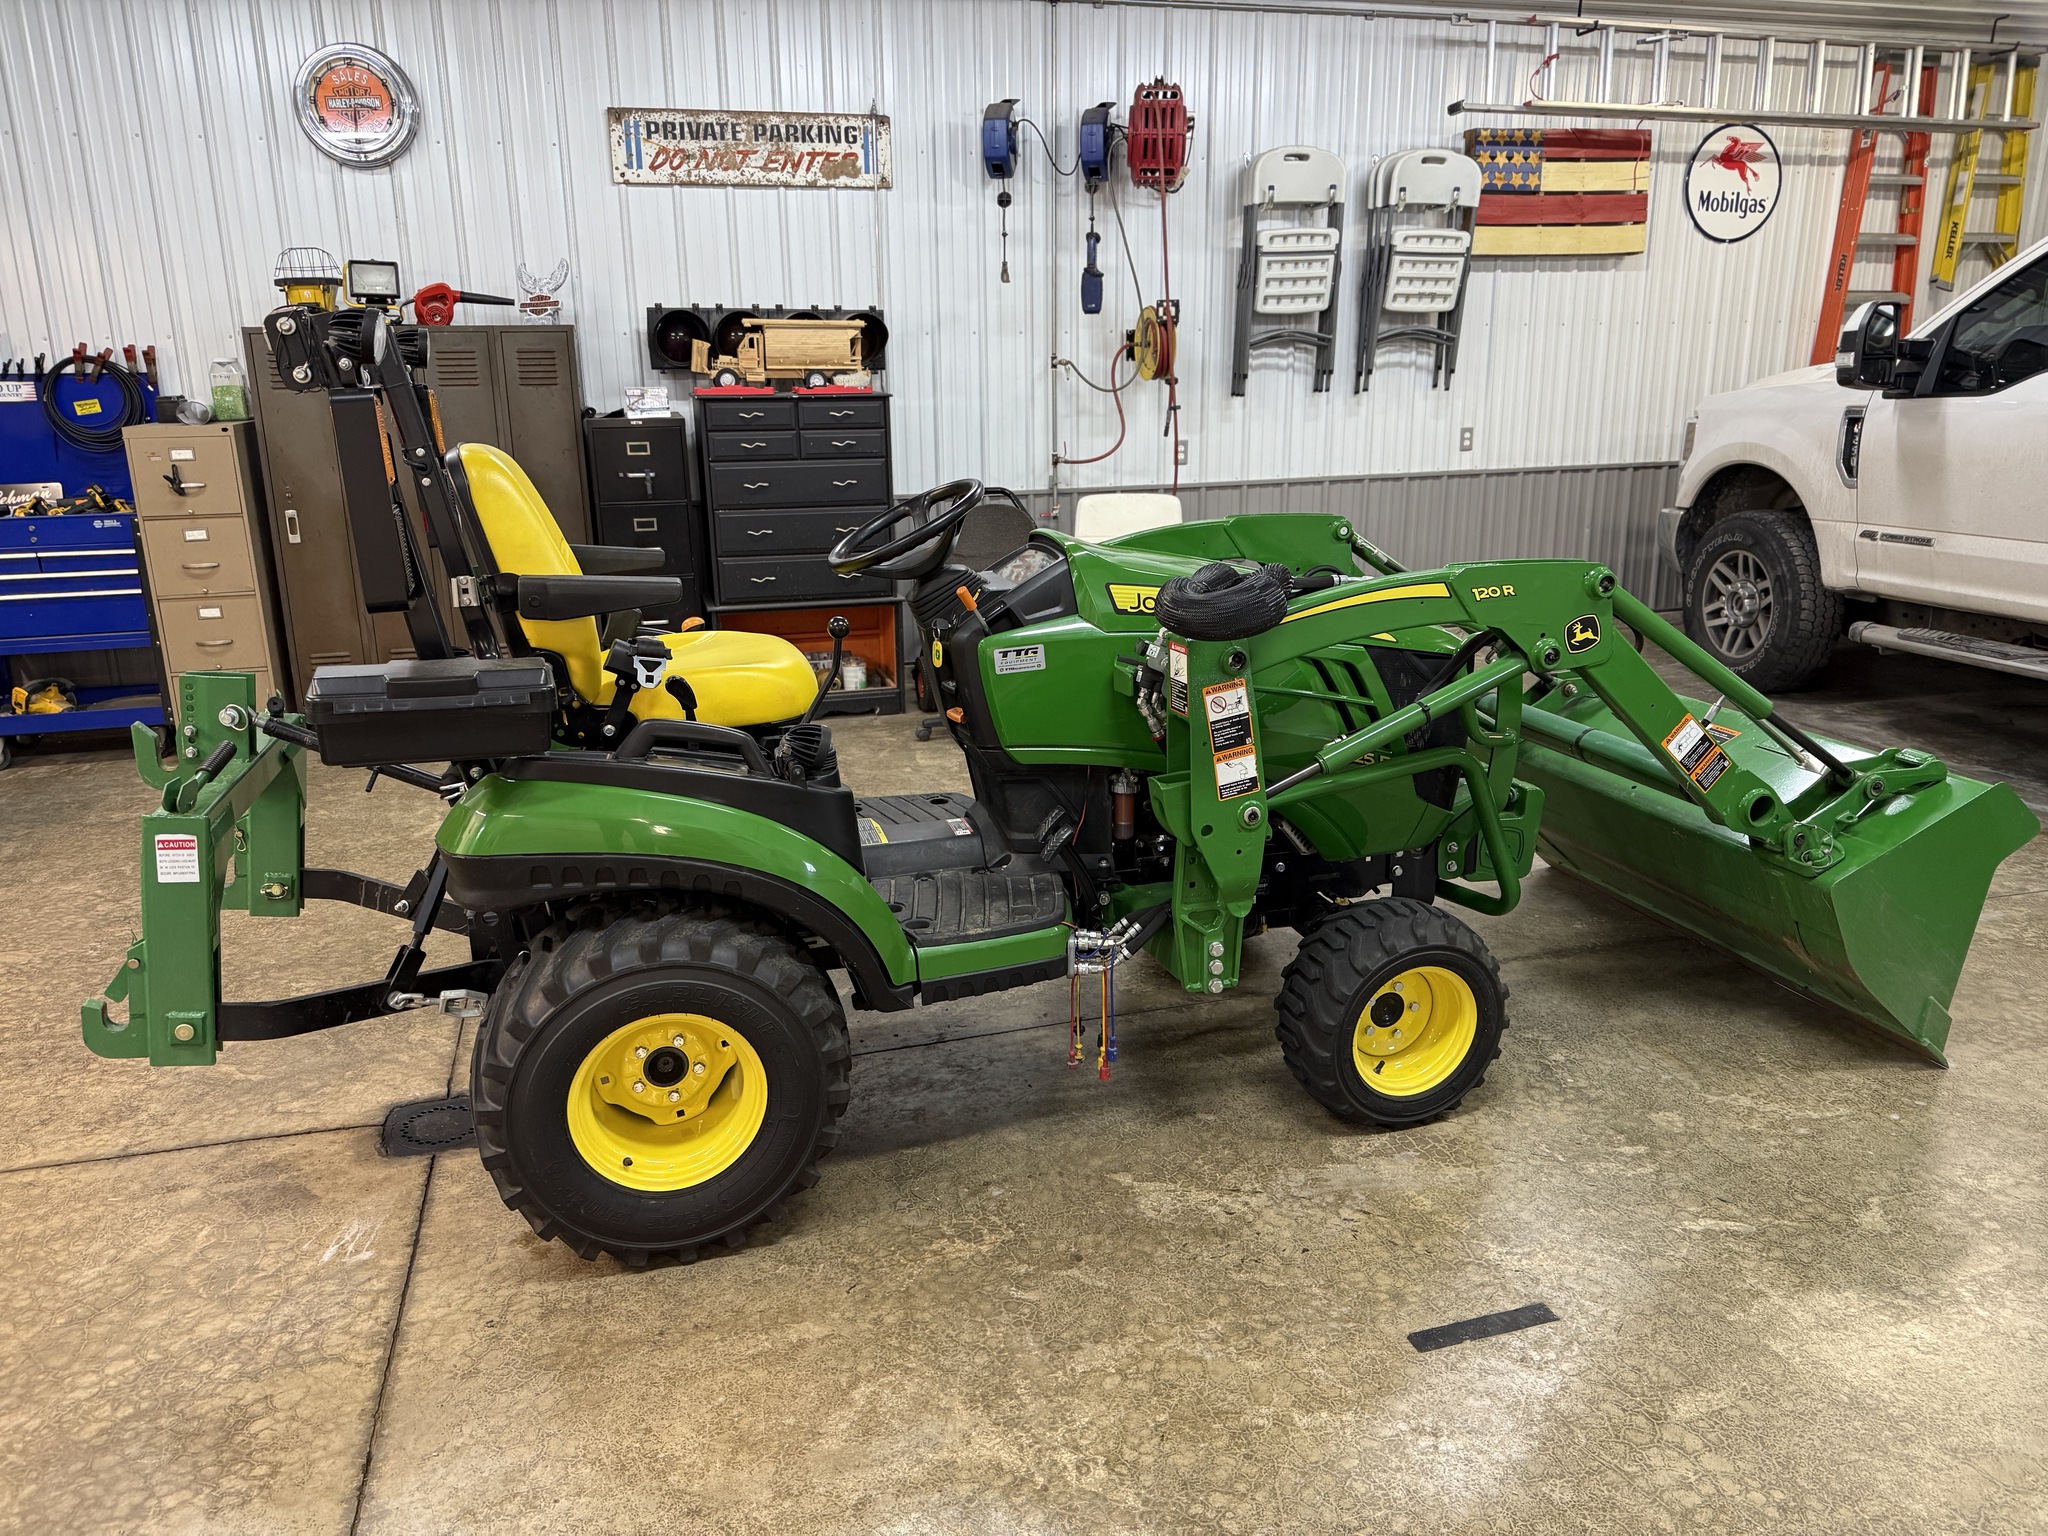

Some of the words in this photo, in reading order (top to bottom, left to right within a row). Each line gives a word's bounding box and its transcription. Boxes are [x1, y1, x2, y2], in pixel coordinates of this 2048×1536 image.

[331, 69, 368, 85] SALES
[338, 86, 366, 96] MOTOR
[645, 120, 743, 142] PRIVATE
[753, 123, 859, 145] PARKING
[648, 148, 687, 172] DO
[695, 149, 758, 172] NOT
[1697, 190, 1767, 219] Mobilgas
[1945, 221, 1960, 259] KELLER
[1834, 253, 1848, 292] KELLER
[6, 384, 21, 393] UP
[0, 489, 52, 505] ehman
[1686, 533, 1744, 608] GOODYEAR
[998, 647, 1039, 660] TTG
[1000, 657, 1037, 665] EQUIPMENT
[1210, 680, 1244, 694] WARNING
[1670, 717, 1689, 739] WARNING
[1221, 747, 1254, 761] WARNING
[1699, 750, 1718, 772] WARNING
